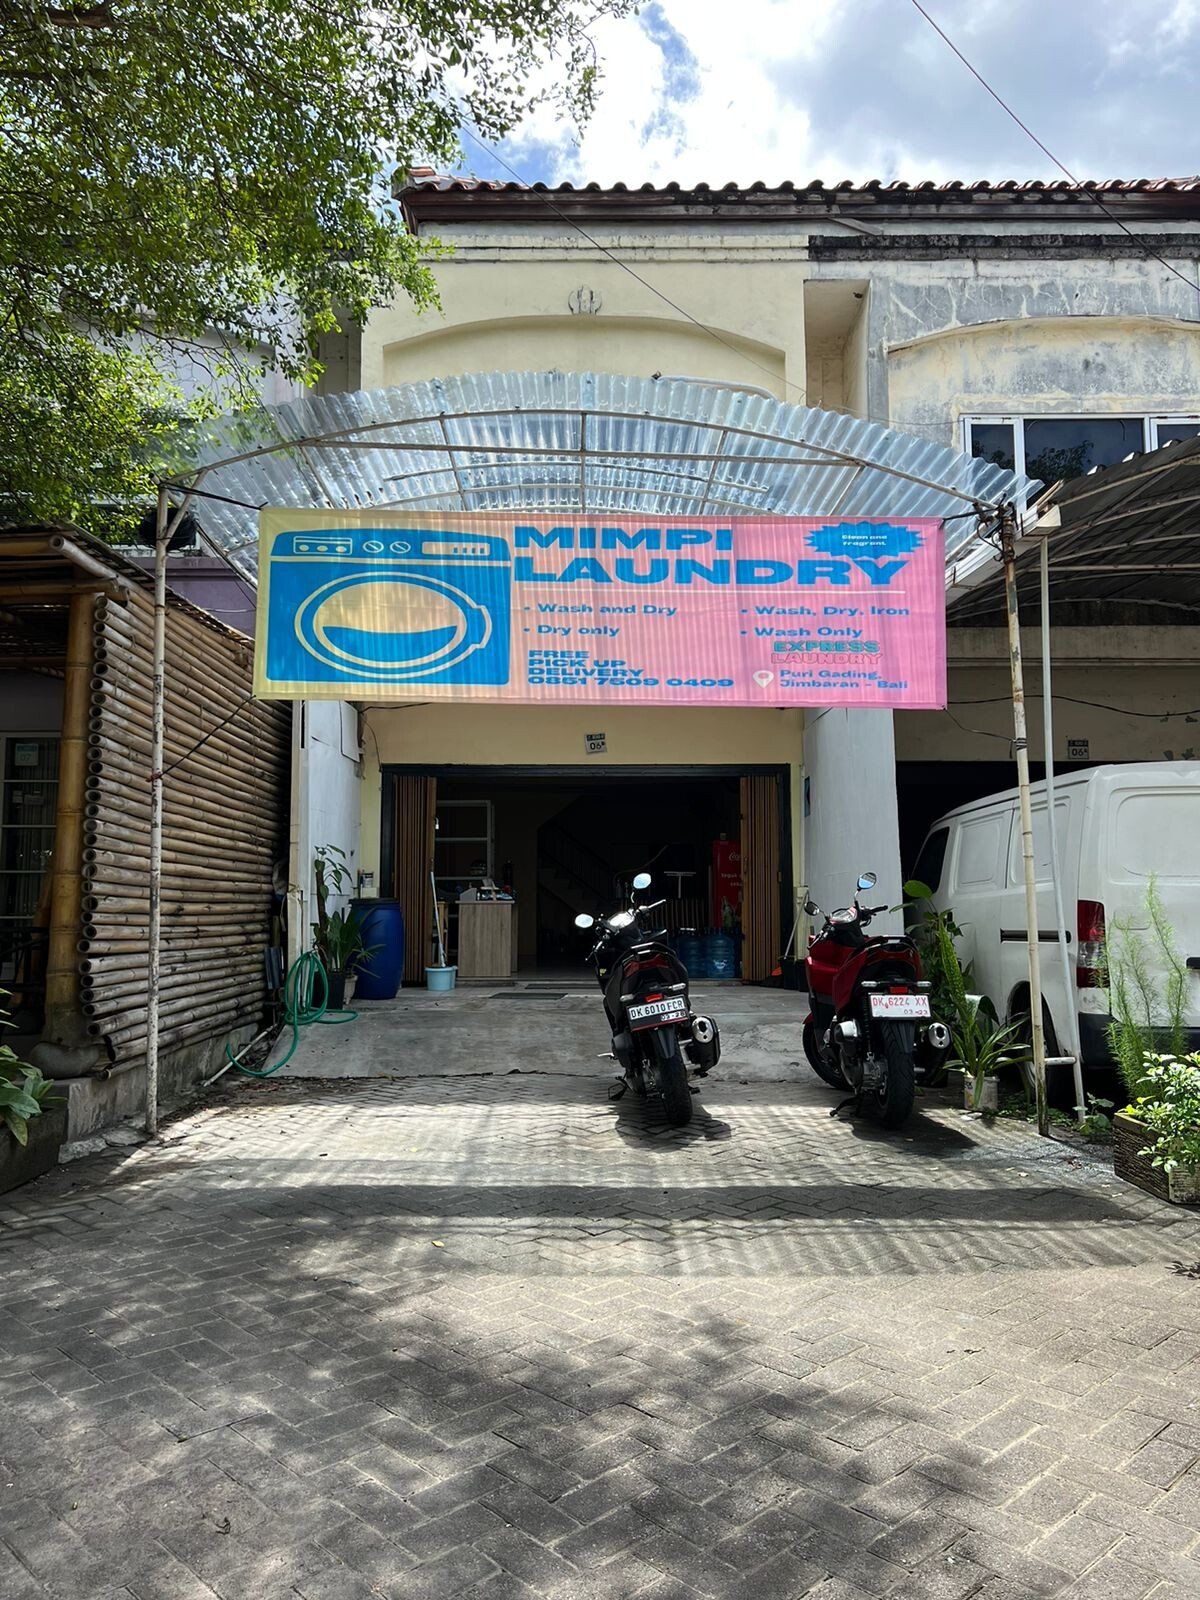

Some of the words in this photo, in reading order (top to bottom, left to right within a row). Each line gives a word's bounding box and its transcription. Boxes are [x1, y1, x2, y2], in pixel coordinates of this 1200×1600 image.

[514, 526, 733, 550] MIMPI
[514, 556, 909, 586] LAUNDRY
[537, 603, 593, 613] Wash
[600, 604, 636, 614] and
[643, 605, 677, 617] Dry
[871, 606, 909, 615] Iron
[537, 624, 571, 636] Dry
[578, 626, 620, 637] only
[754, 627, 811, 636] Wash
[817, 627, 863, 638] Only
[773, 641, 880, 653] EXPRESS
[528, 650, 590, 659] FREE
[770, 653, 883, 664] LAUNDRY
[528, 659, 586, 667] PICK
[593, 660, 626, 668] UP
[528, 668, 645, 677] DELIVERY
[780, 669, 813, 678] Puri
[528, 676, 587, 685] 0851
[594, 677, 660, 686] 7509
[666, 678, 734, 687] 0409
[780, 679, 859, 688] Jimbaran
[877, 681, 908, 689] Bali
[872, 997, 885, 1006] DK
[915, 997, 927, 1006] XX
[631, 1008, 643, 1018] DK
[645, 1003, 666, 1015] 6010
[667, 1000, 683, 1010] FCR
